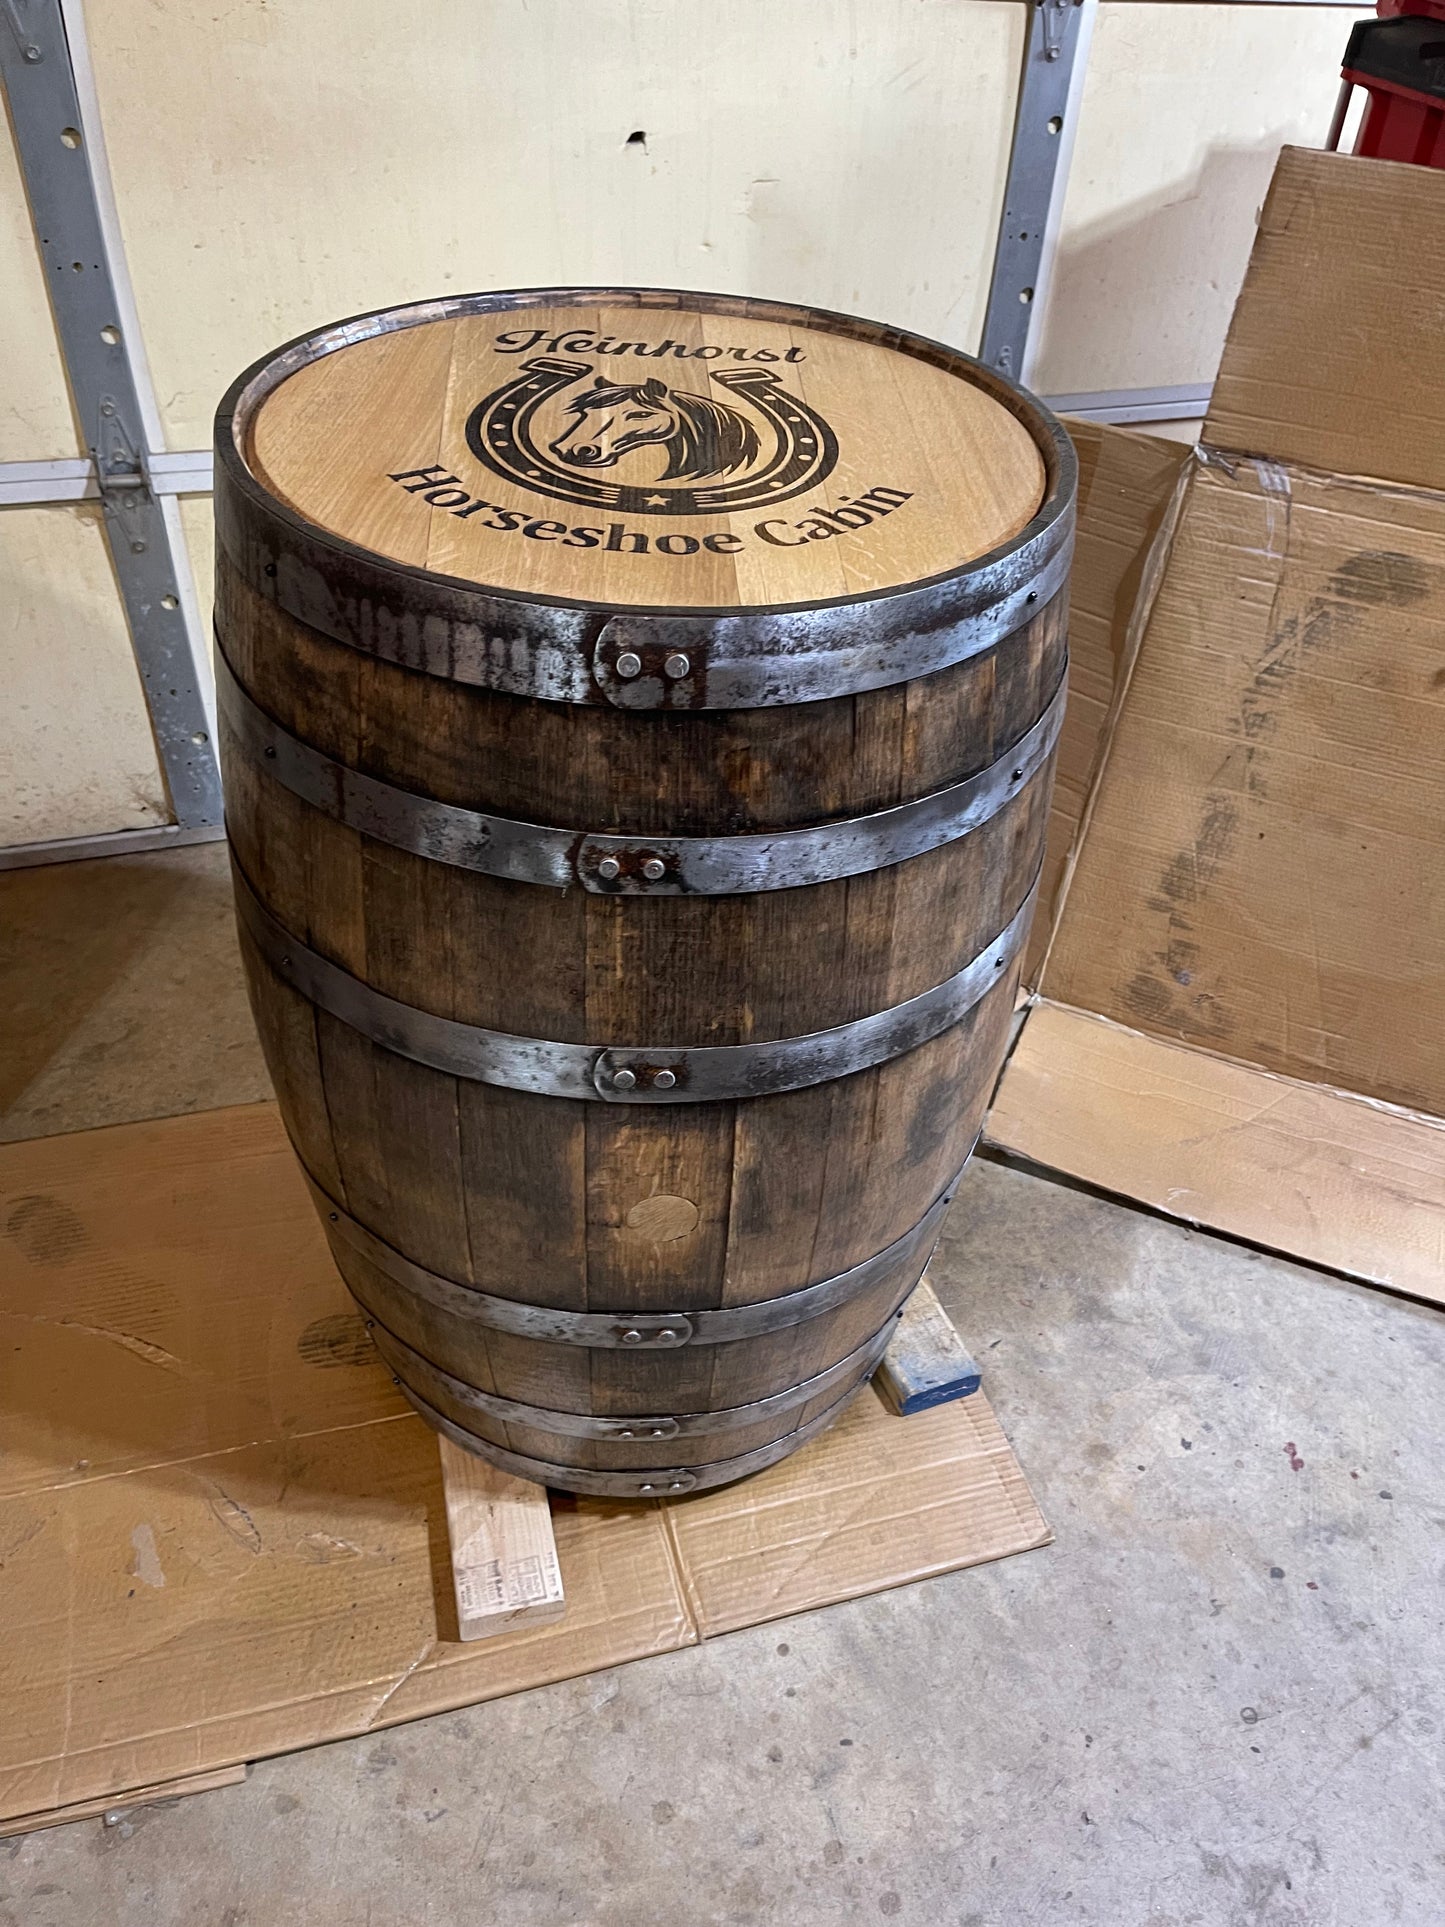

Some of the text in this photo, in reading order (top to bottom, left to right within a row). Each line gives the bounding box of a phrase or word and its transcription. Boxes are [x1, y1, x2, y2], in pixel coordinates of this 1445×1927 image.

[493, 329, 806, 364] Heinhorst
[386, 463, 915, 556] Horseshoe Cabin
